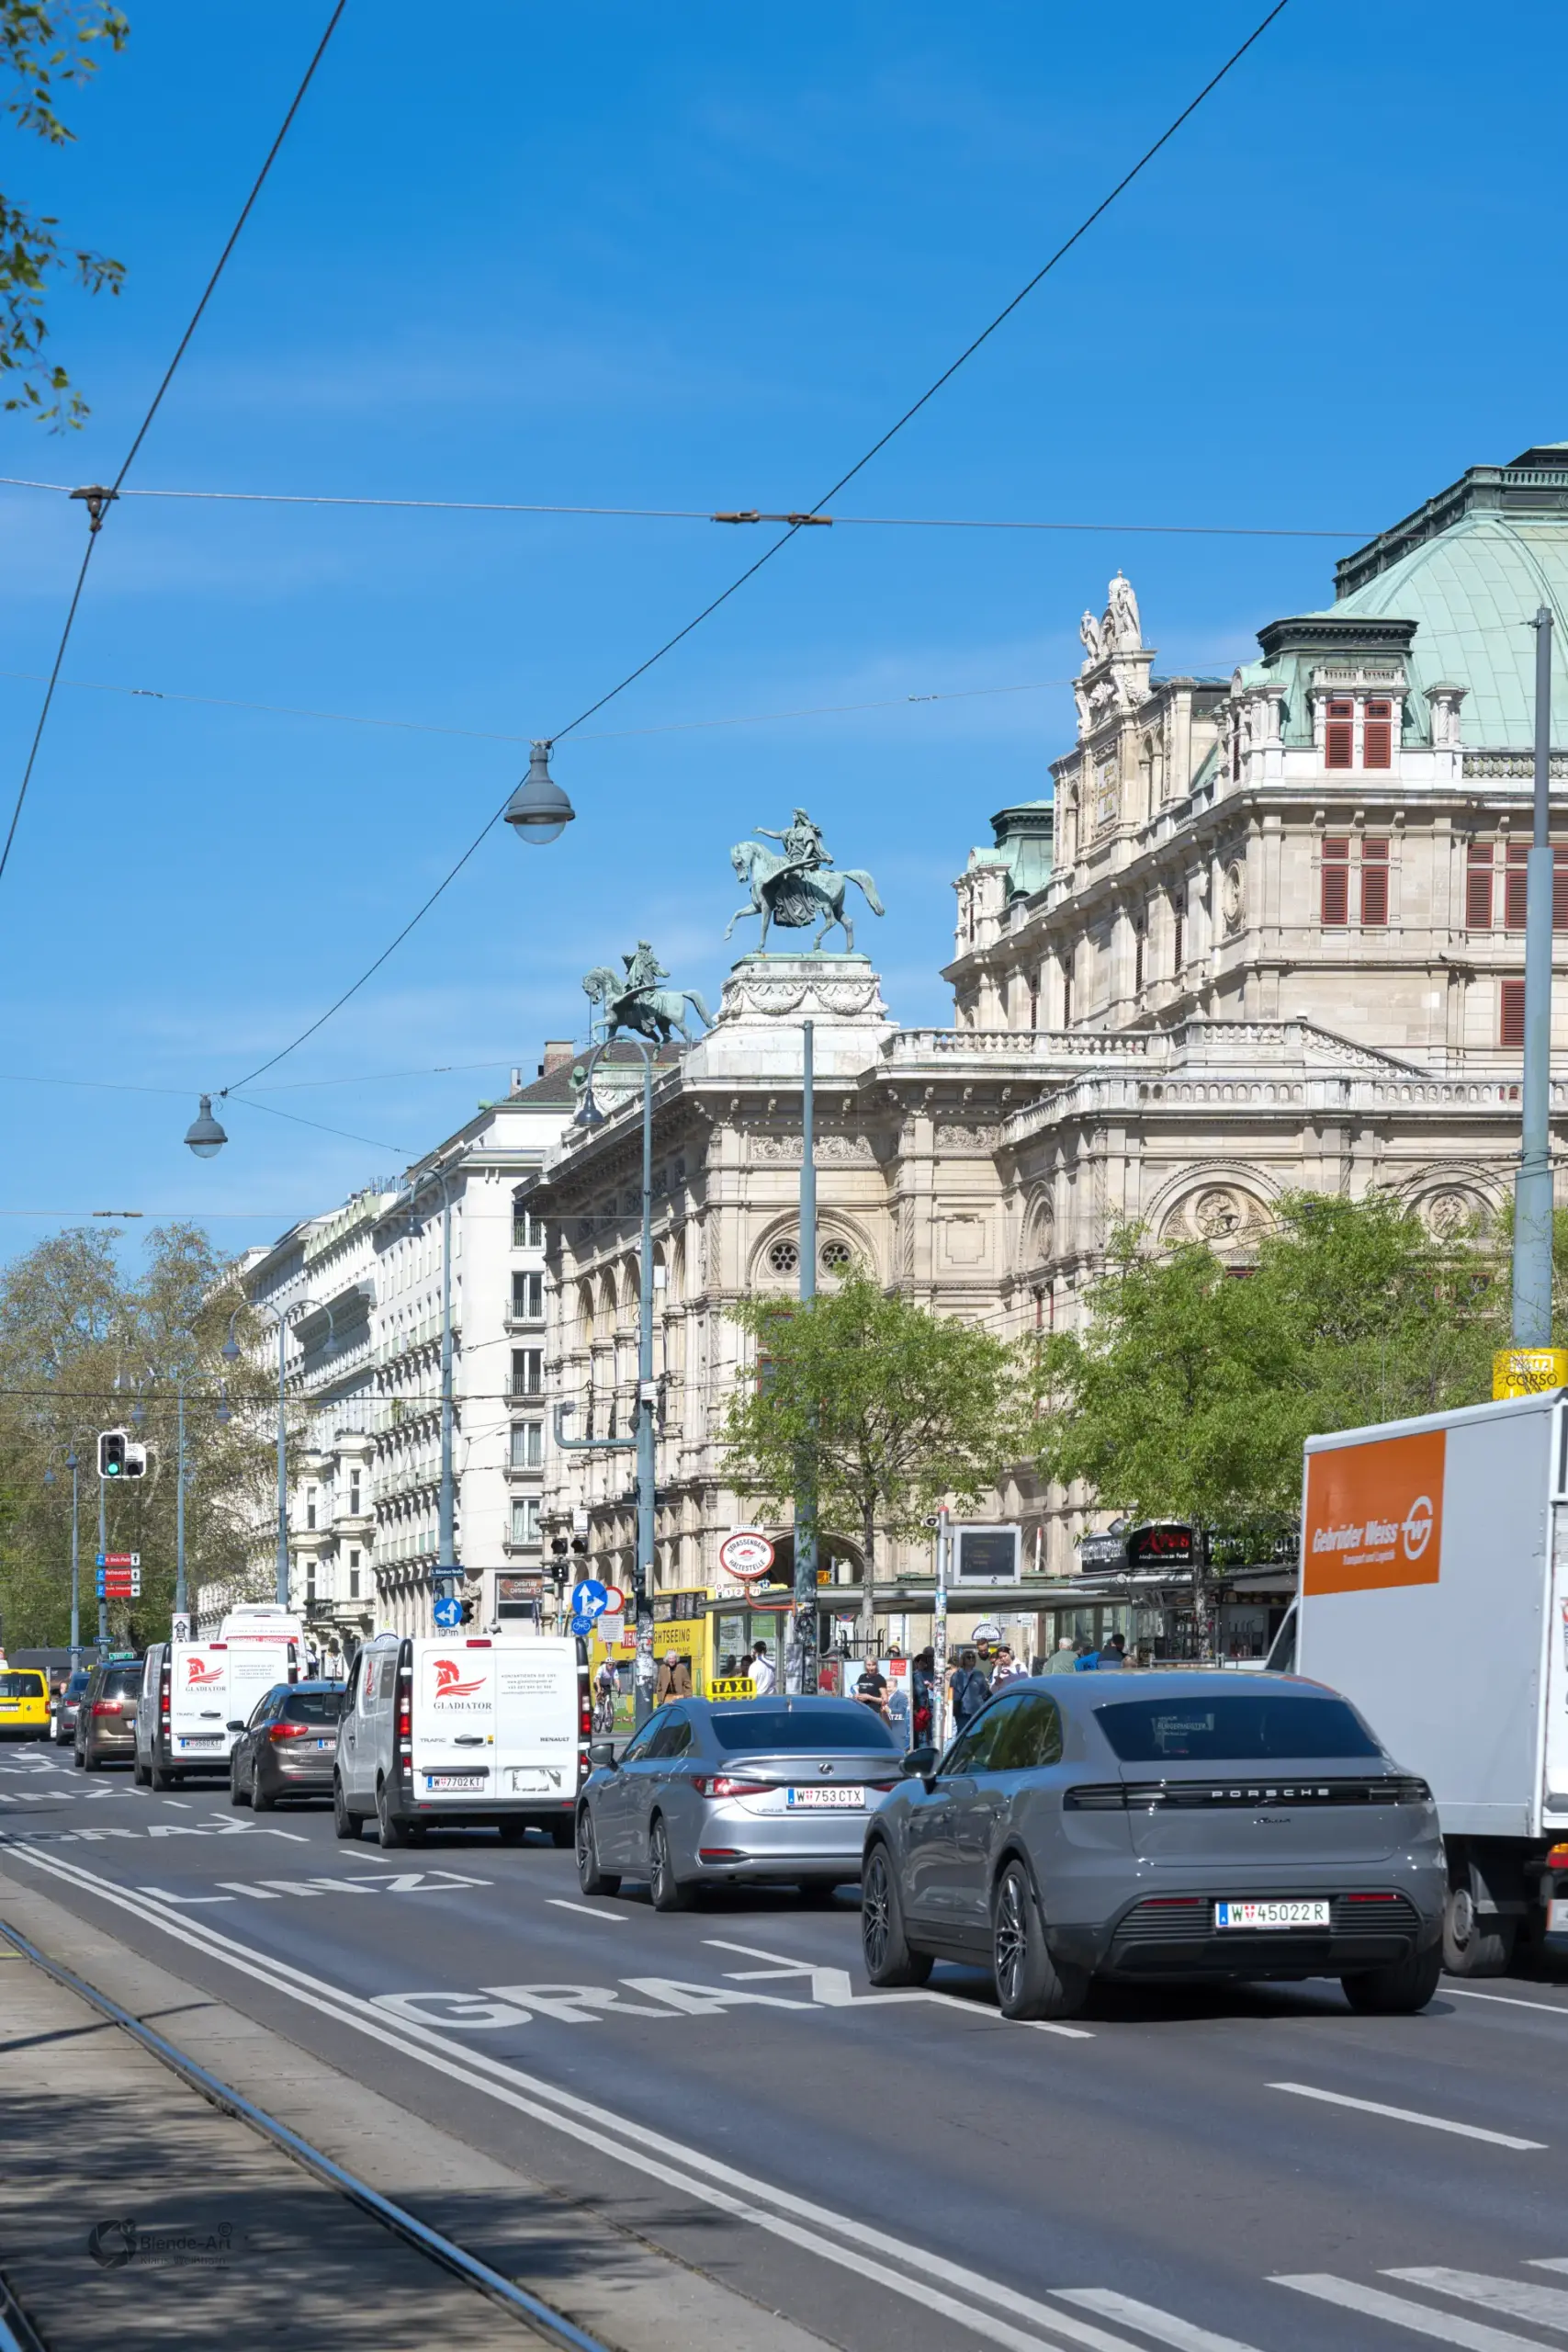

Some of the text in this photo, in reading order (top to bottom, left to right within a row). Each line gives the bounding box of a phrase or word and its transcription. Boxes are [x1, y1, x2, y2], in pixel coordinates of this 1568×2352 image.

[1506, 1374, 1557, 1386] CORSO
[1313, 1523, 1363, 1553] Gebrüder
[1365, 1519, 1399, 1545] Weiss
[727, 1539, 767, 1553] STRASSENBAHN
[729, 1559, 765, 1571] HALTESTELLE
[653, 1628, 691, 1644] GHTSEEING
[714, 1680, 750, 1692] TAXI
[434, 1702, 492, 1710] GLADIATOR
[1212, 1789, 1329, 1798] PORSCHE
[135, 1873, 474, 1903] LINZ
[370, 1967, 935, 2028] GRAZ
